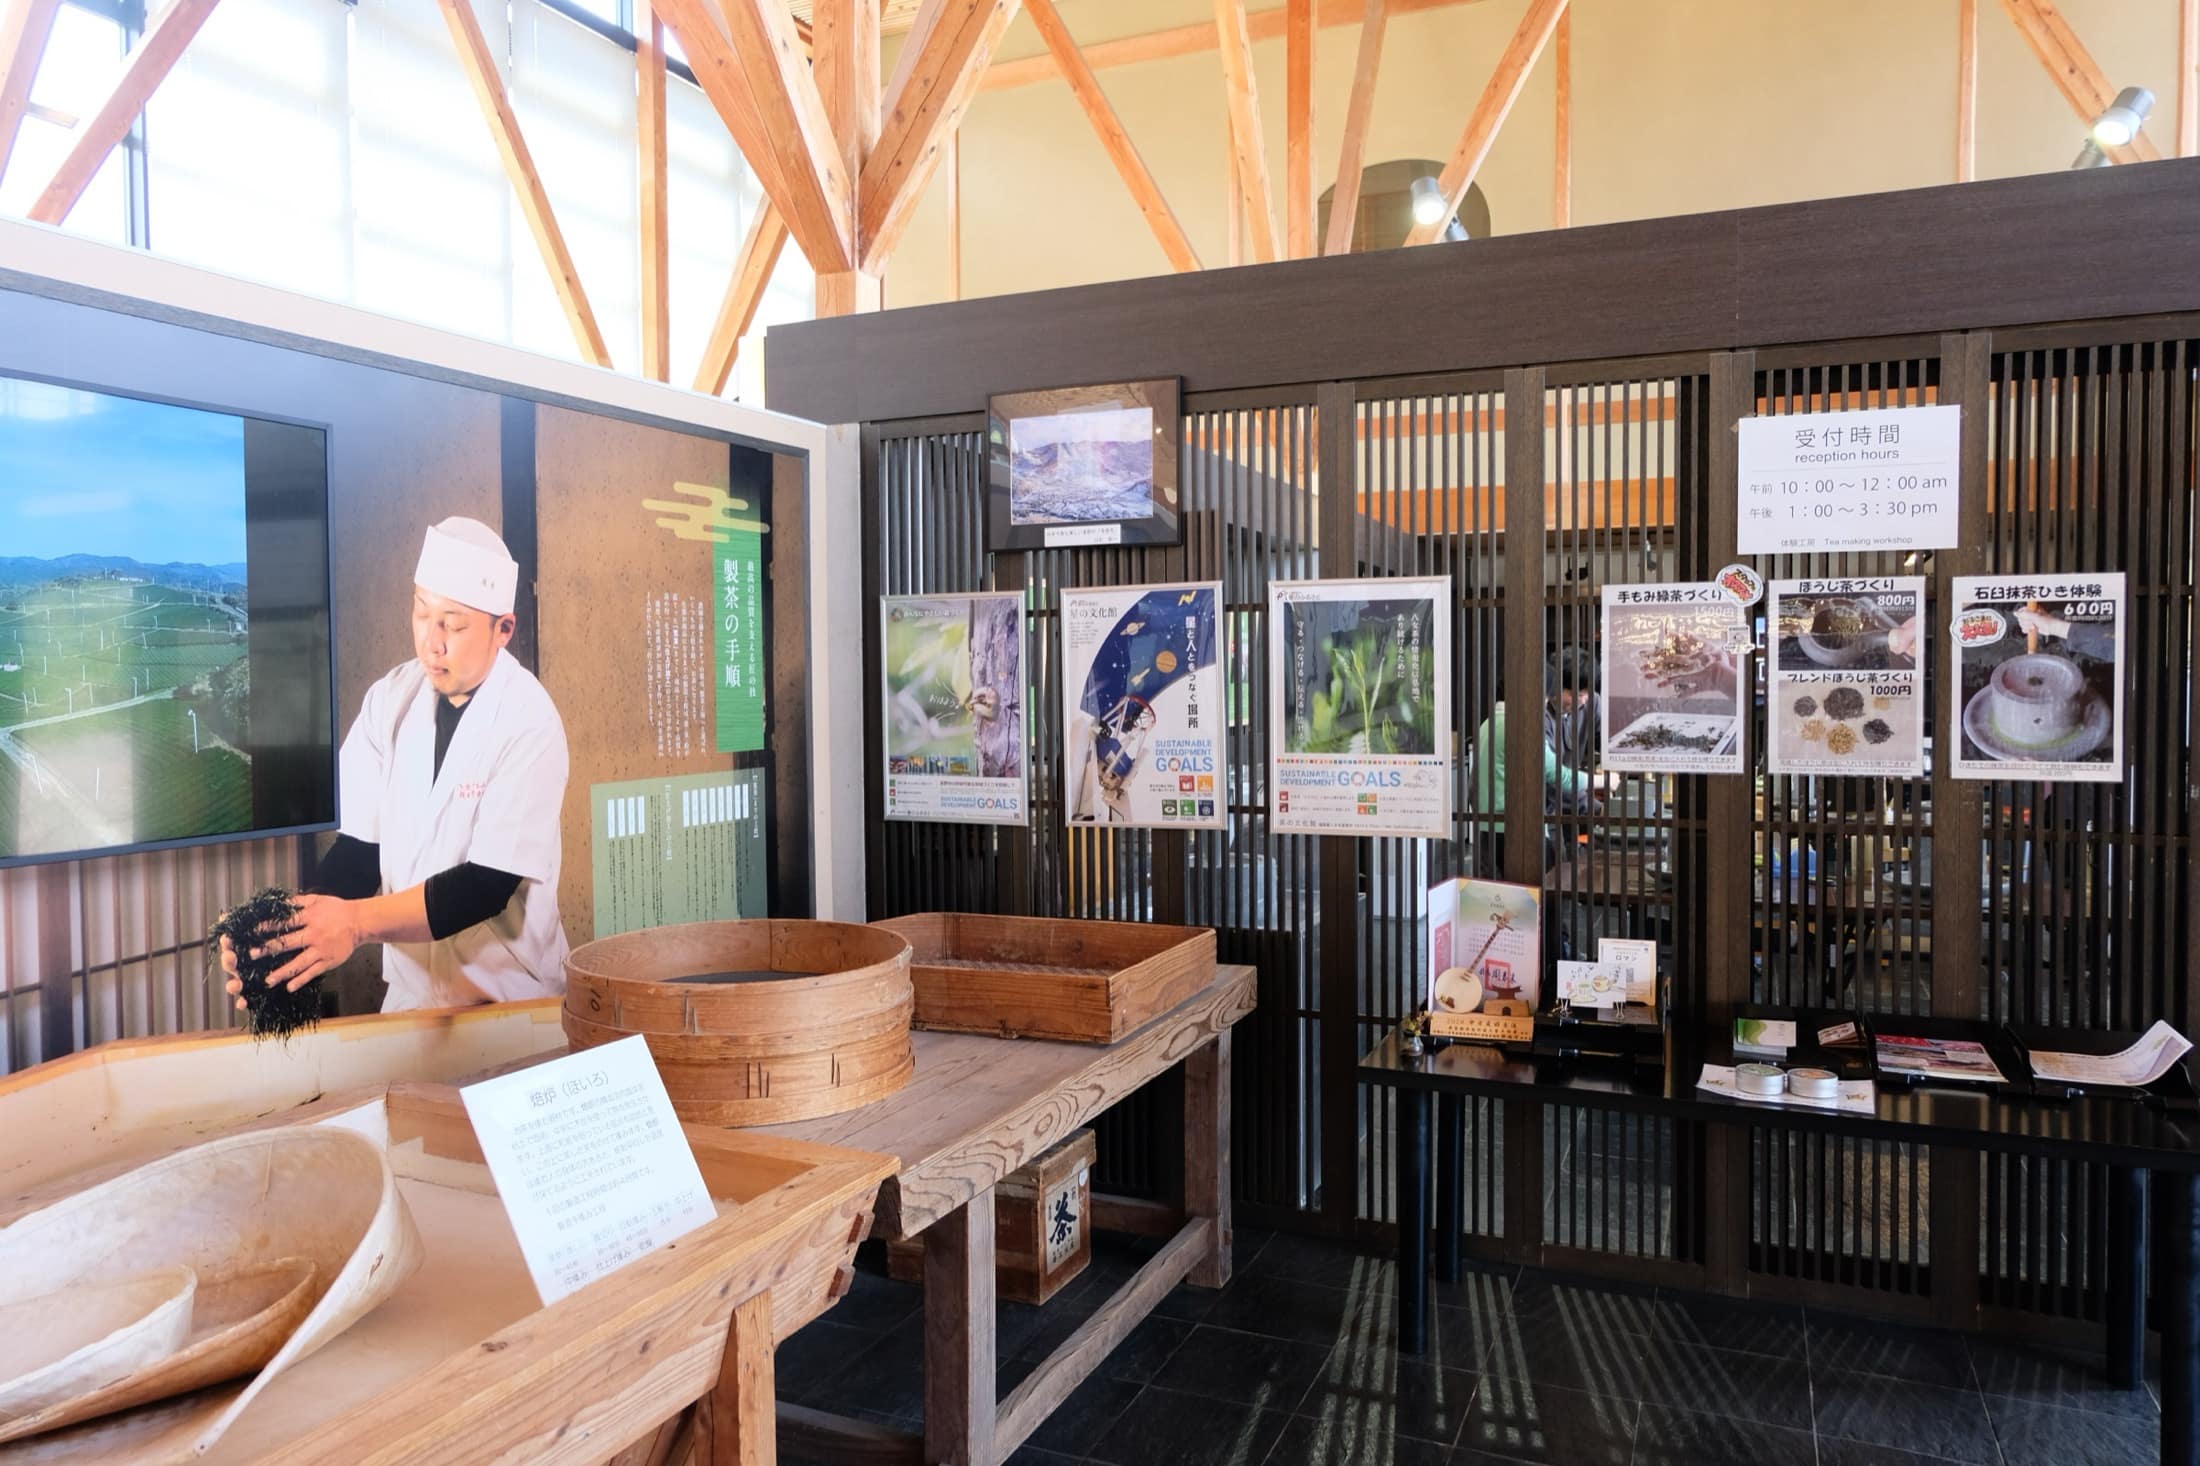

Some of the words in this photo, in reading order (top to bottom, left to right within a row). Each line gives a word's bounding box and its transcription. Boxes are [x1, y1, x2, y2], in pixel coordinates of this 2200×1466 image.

[1795, 424, 1900, 449] 受付時間
[1795, 451, 1856, 464] reception
[1861, 448, 1899, 460] hours
[1749, 483, 1773, 494] 午前
[1922, 476, 1947, 489] am
[1749, 507, 1773, 519] 午後
[1911, 501, 1938, 519] pm
[1781, 538, 1815, 547] 体験工房
[1824, 538, 1839, 546] Tea
[1841, 537, 1871, 547] making
[1873, 536, 1913, 546] workshop
[1799, 579, 1895, 593] ほうじ茶づくり
[1974, 584, 2102, 600] 石臼抹茶ひき体験
[1617, 589, 1723, 604] 手もみ緑茶づくり
[1877, 595, 1915, 606] 800円
[2063, 602, 2113, 616] 600円
[723, 558, 742, 688] 製茶の手順
[1788, 672, 1913, 683] ブレンドほうじ茶づくり
[1870, 685, 1912, 696] 1000円
[1155, 739, 1212, 748] SUSTAINABLE
[1155, 748, 1211, 756] DEVELOPMENT
[1156, 757, 1213, 772] GOALS
[1280, 770, 1336, 778] SUSTAINABLE
[1338, 771, 1401, 787] GOALS
[1280, 778, 1336, 786] DEVELOPMENT
[977, 798, 1017, 809] GOALS
[1048, 1192, 1077, 1245] 茶
